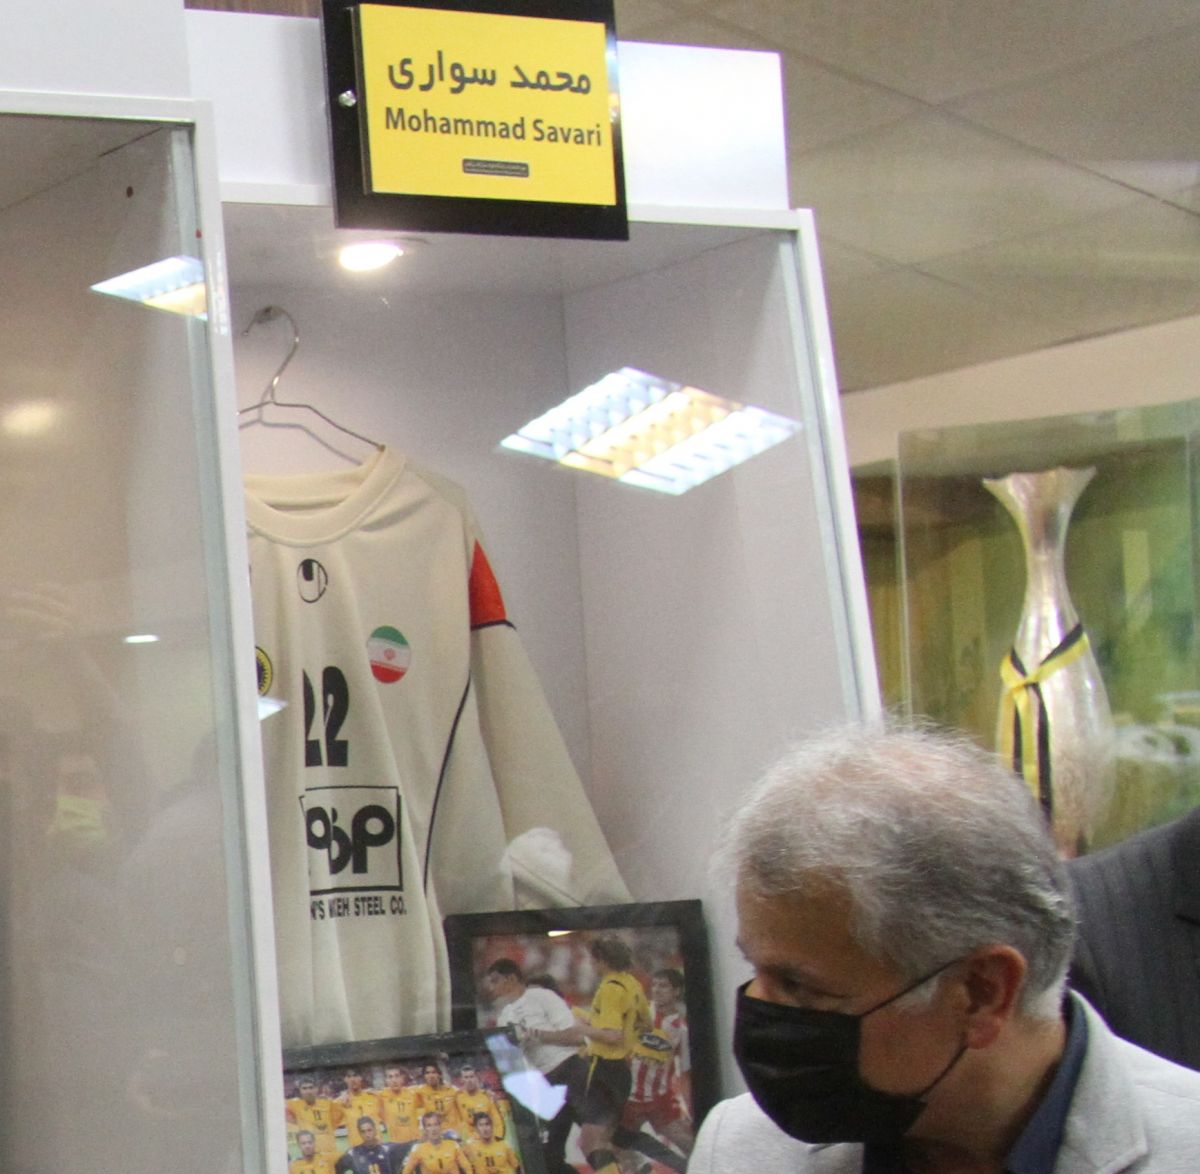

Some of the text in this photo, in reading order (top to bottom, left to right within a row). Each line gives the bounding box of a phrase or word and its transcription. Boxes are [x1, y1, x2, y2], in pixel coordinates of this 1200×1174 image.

[388, 50, 591, 95] محمد سواری
[385, 107, 601, 146] Mohammad Savari
[354, 896, 386, 917] STEEL
